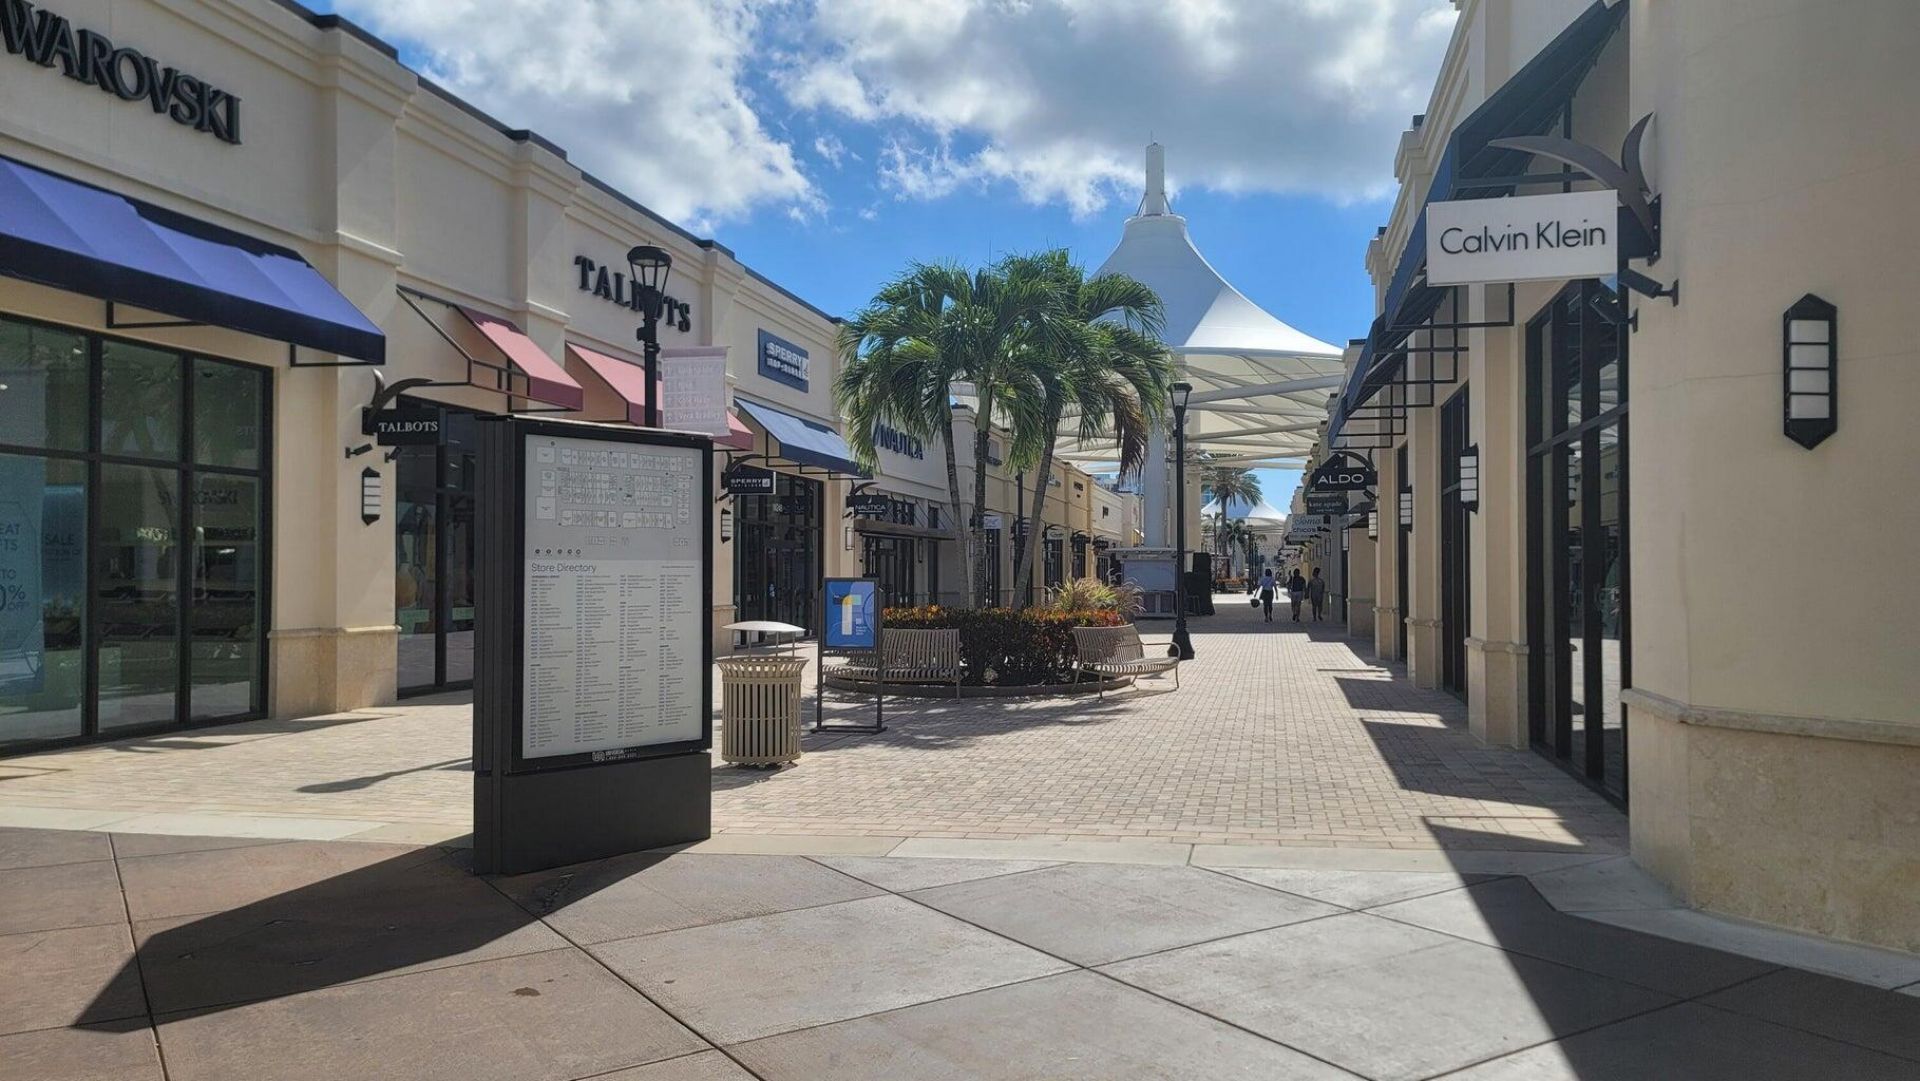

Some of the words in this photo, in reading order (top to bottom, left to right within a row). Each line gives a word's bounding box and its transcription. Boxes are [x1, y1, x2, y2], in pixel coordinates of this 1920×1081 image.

[0, 0, 242, 145] WAROVSKI
[1440, 224, 1528, 254] Calvin
[1537, 219, 1606, 249] Klein
[766, 342, 803, 366] SPERRY
[378, 421, 439, 432] TALBOTS
[1317, 474, 1365, 484] ALDO
[531, 562, 555, 572] Store
[556, 562, 597, 573] Directory
